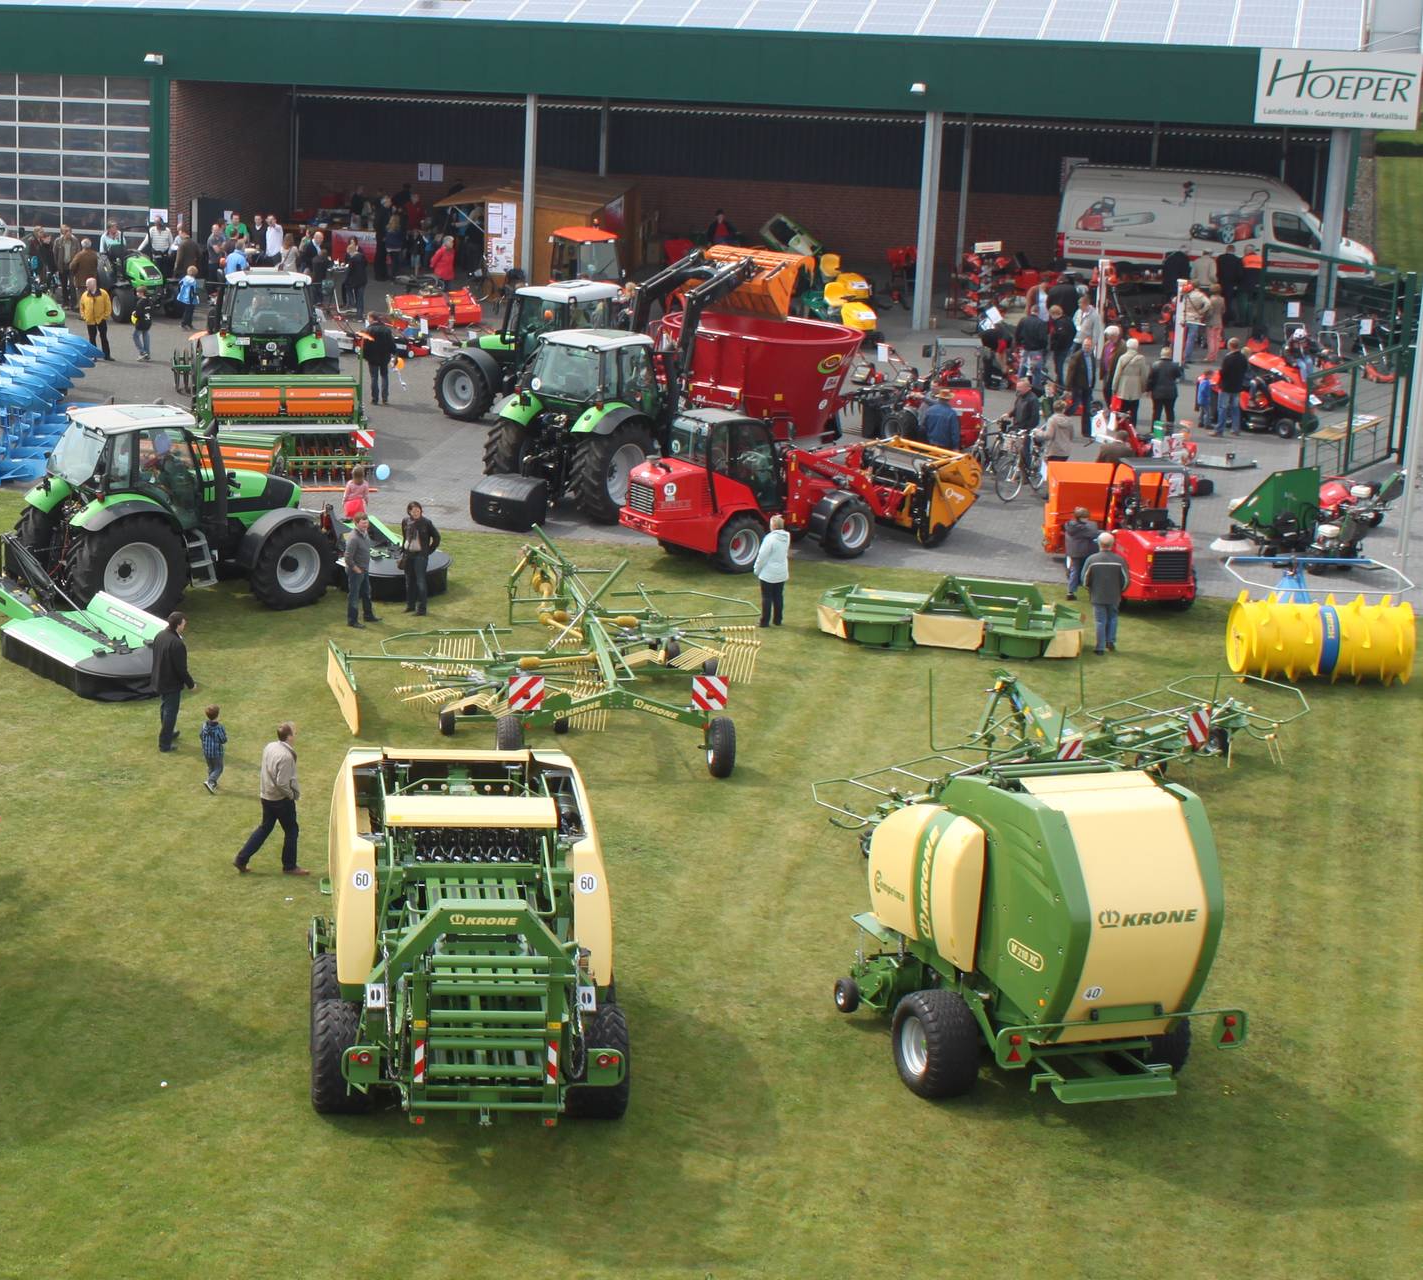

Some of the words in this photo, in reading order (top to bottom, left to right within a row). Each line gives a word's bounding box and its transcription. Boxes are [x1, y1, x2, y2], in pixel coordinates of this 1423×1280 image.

[1265, 58, 1417, 103] HOEPER
[1263, 107, 1309, 116] Landtechnik
[1314, 109, 1364, 120] Gartengeräte
[1370, 112, 1408, 121] Metallbau
[565, 700, 601, 717] KRONE
[642, 703, 680, 720] KRONE
[919, 824, 940, 912] KRONE
[355, 873, 369, 887] 60
[580, 876, 594, 890] 60
[465, 917, 519, 926] KRONE
[1122, 908, 1198, 928] KRONE
[1085, 987, 1102, 1000] 40
